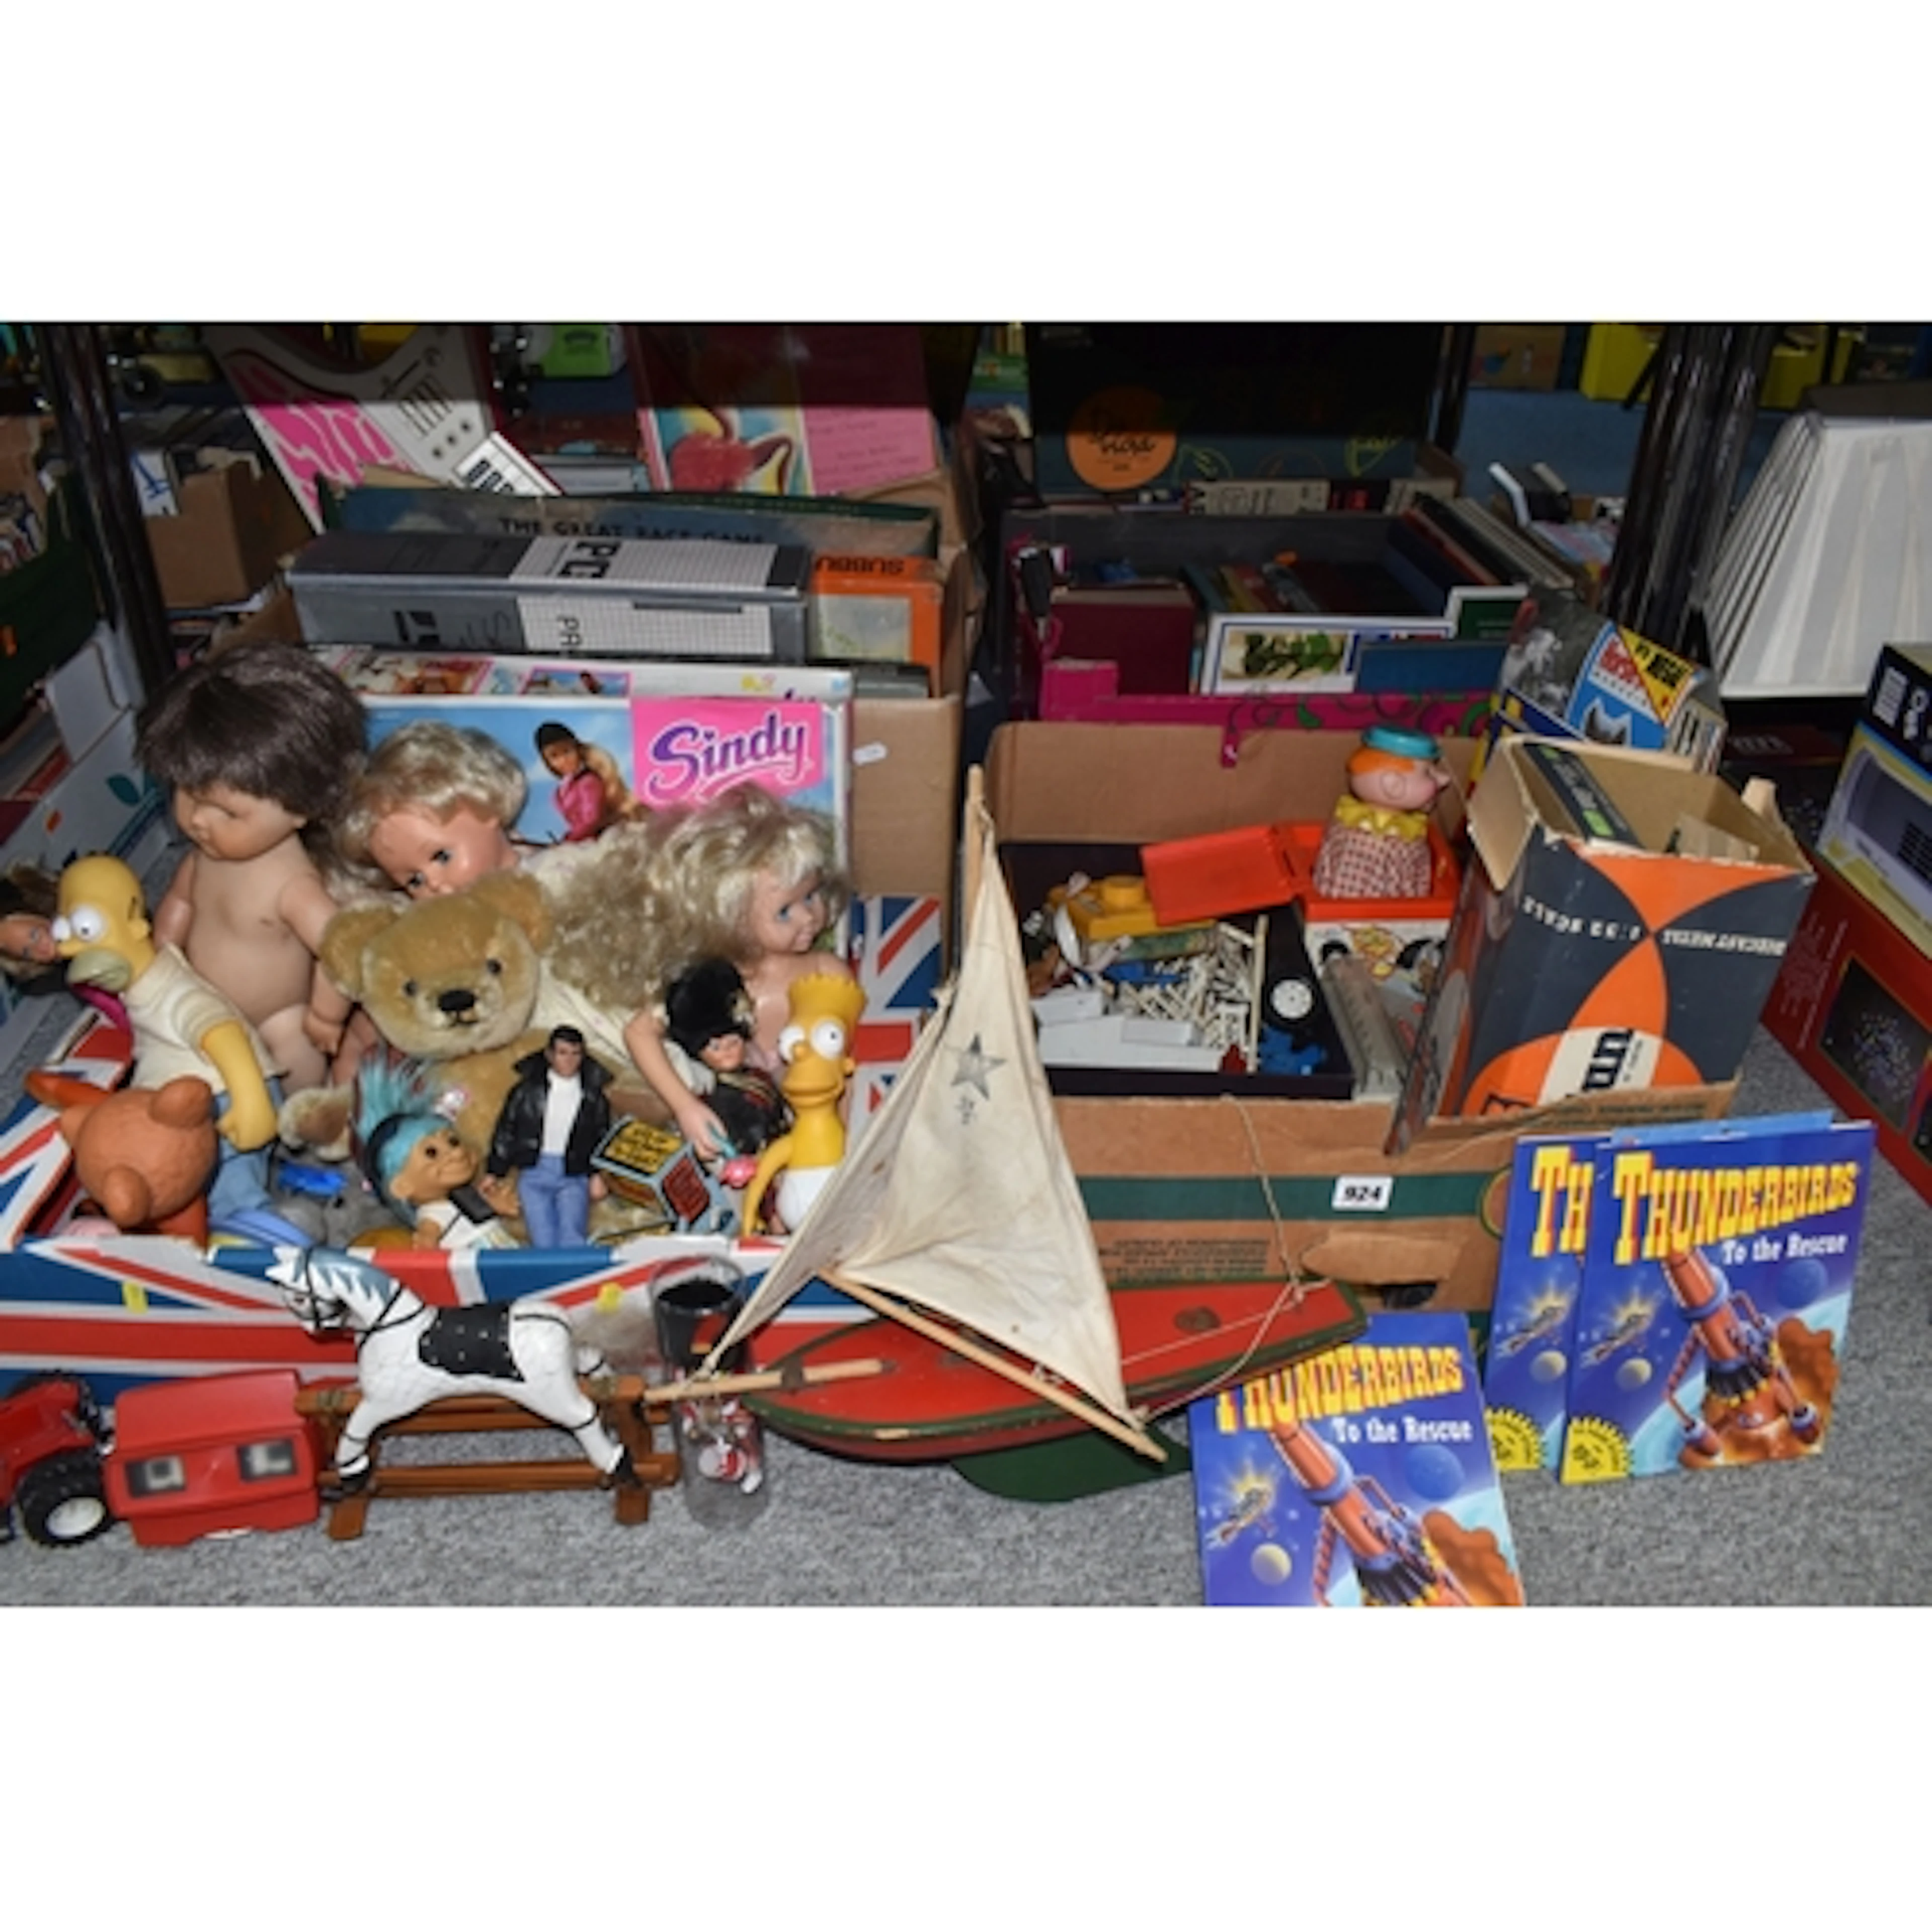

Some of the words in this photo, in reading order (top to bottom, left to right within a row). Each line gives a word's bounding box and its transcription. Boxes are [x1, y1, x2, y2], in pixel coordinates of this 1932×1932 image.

[648, 712, 808, 802] Sindy
[1344, 1185, 1383, 1201] 924
[1614, 1151, 1859, 1265] THUNDERBIRDS
[1722, 1239, 1747, 1265] To
[1753, 1238, 1780, 1261] the
[1787, 1233, 1848, 1258] Rescue
[1331, 1417, 1357, 1443] To
[1366, 1417, 1397, 1442] the
[1404, 1415, 1472, 1443] Rescue
